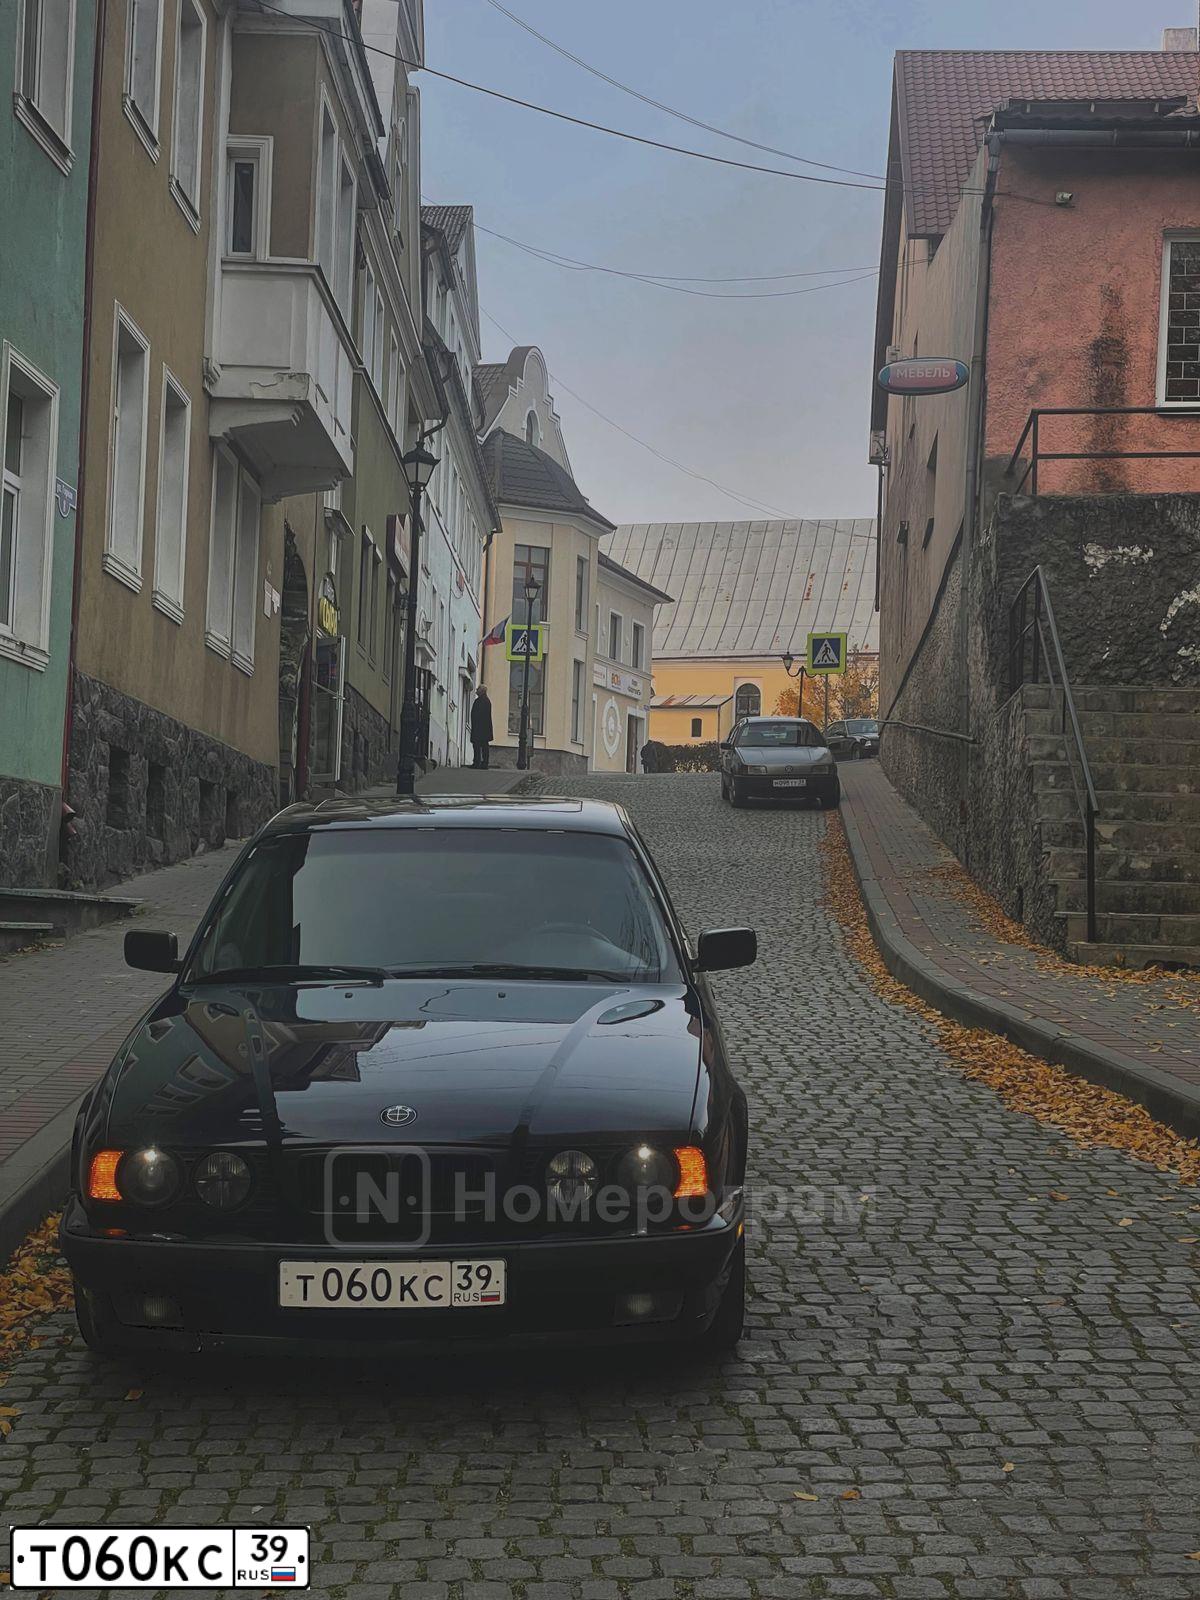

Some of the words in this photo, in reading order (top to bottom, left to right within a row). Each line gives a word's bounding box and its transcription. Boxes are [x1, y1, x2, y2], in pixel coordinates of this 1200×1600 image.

[896, 367, 951, 379] МЕБЕЛЬ
[296, 1267, 444, 1302] Т060КС
[456, 1264, 493, 1291] 39
[453, 1292, 480, 1303] RUS
